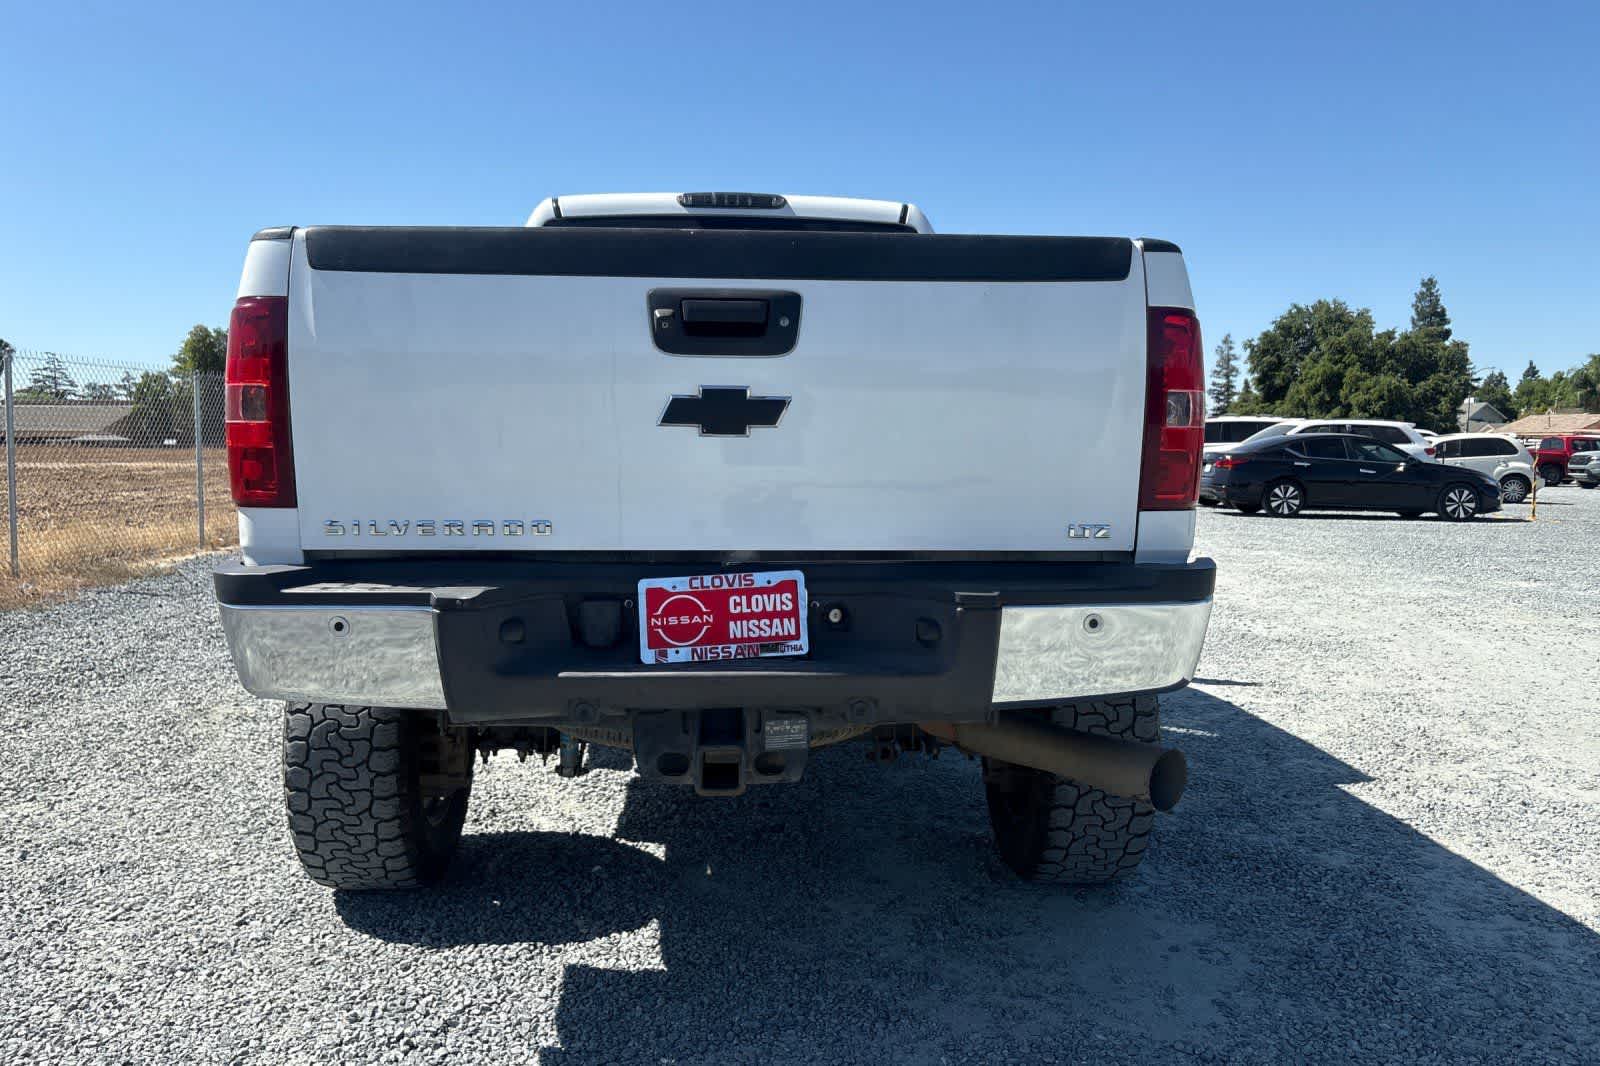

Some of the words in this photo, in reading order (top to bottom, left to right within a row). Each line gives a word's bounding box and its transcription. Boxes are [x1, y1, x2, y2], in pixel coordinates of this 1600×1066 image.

[324, 519, 553, 537] SILVERADO
[688, 573, 755, 590] CLOVIS
[728, 592, 793, 614] CLOVIS
[650, 614, 714, 626] NISSAN
[728, 617, 796, 639] NISSAN
[690, 643, 761, 661] NISSAN
